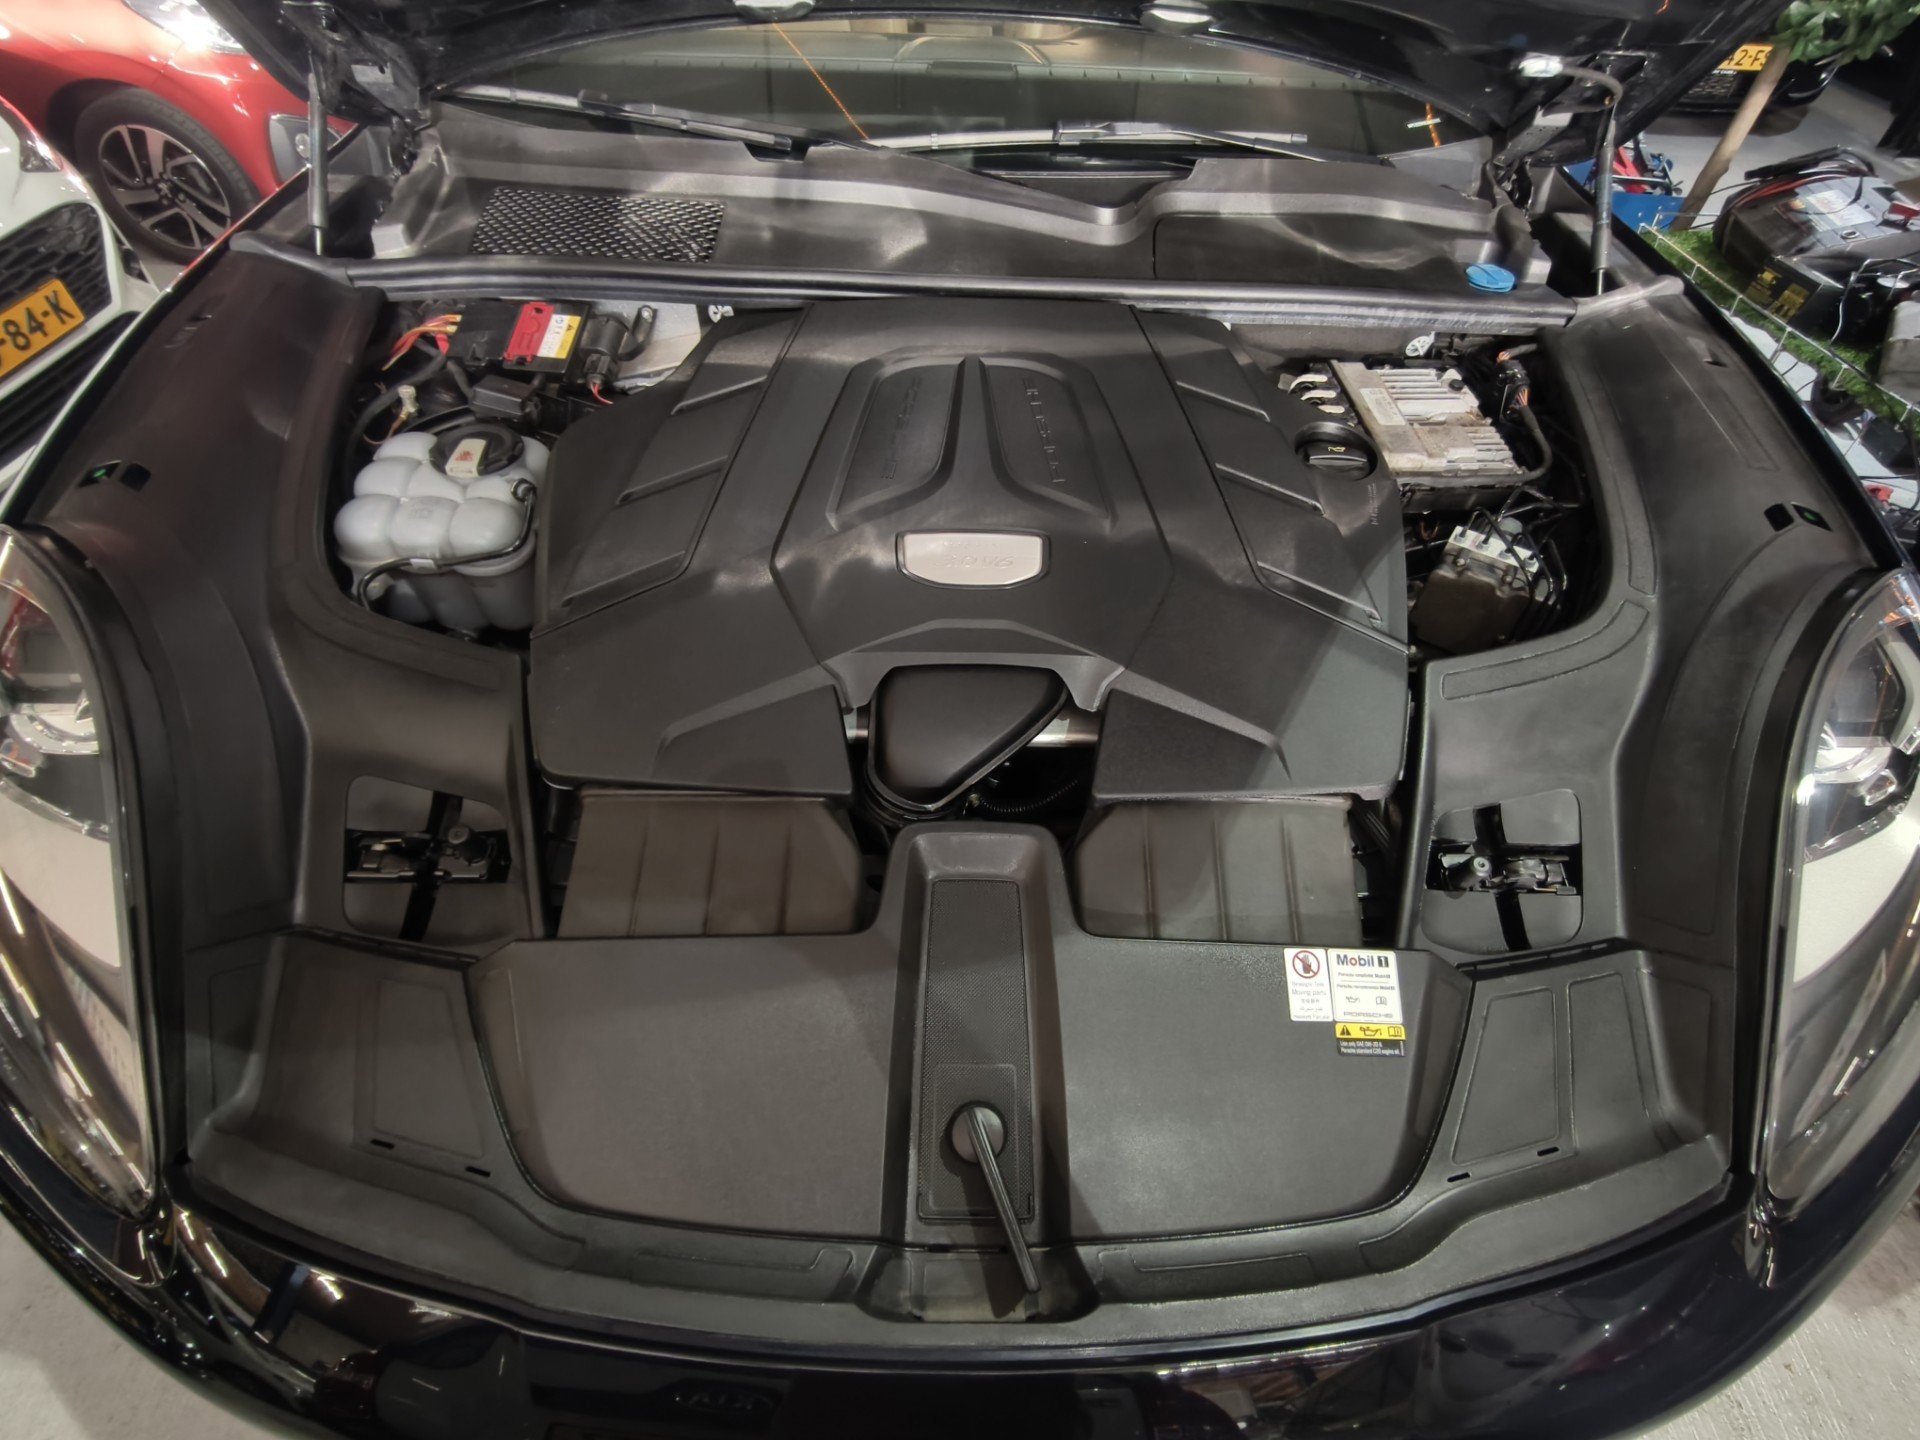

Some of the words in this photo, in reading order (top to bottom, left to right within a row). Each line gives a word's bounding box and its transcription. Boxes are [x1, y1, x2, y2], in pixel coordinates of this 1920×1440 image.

[0, 290, 75, 368] -84-K
[1336, 954, 1374, 967] Mobil
[1377, 955, 1389, 968] 1
